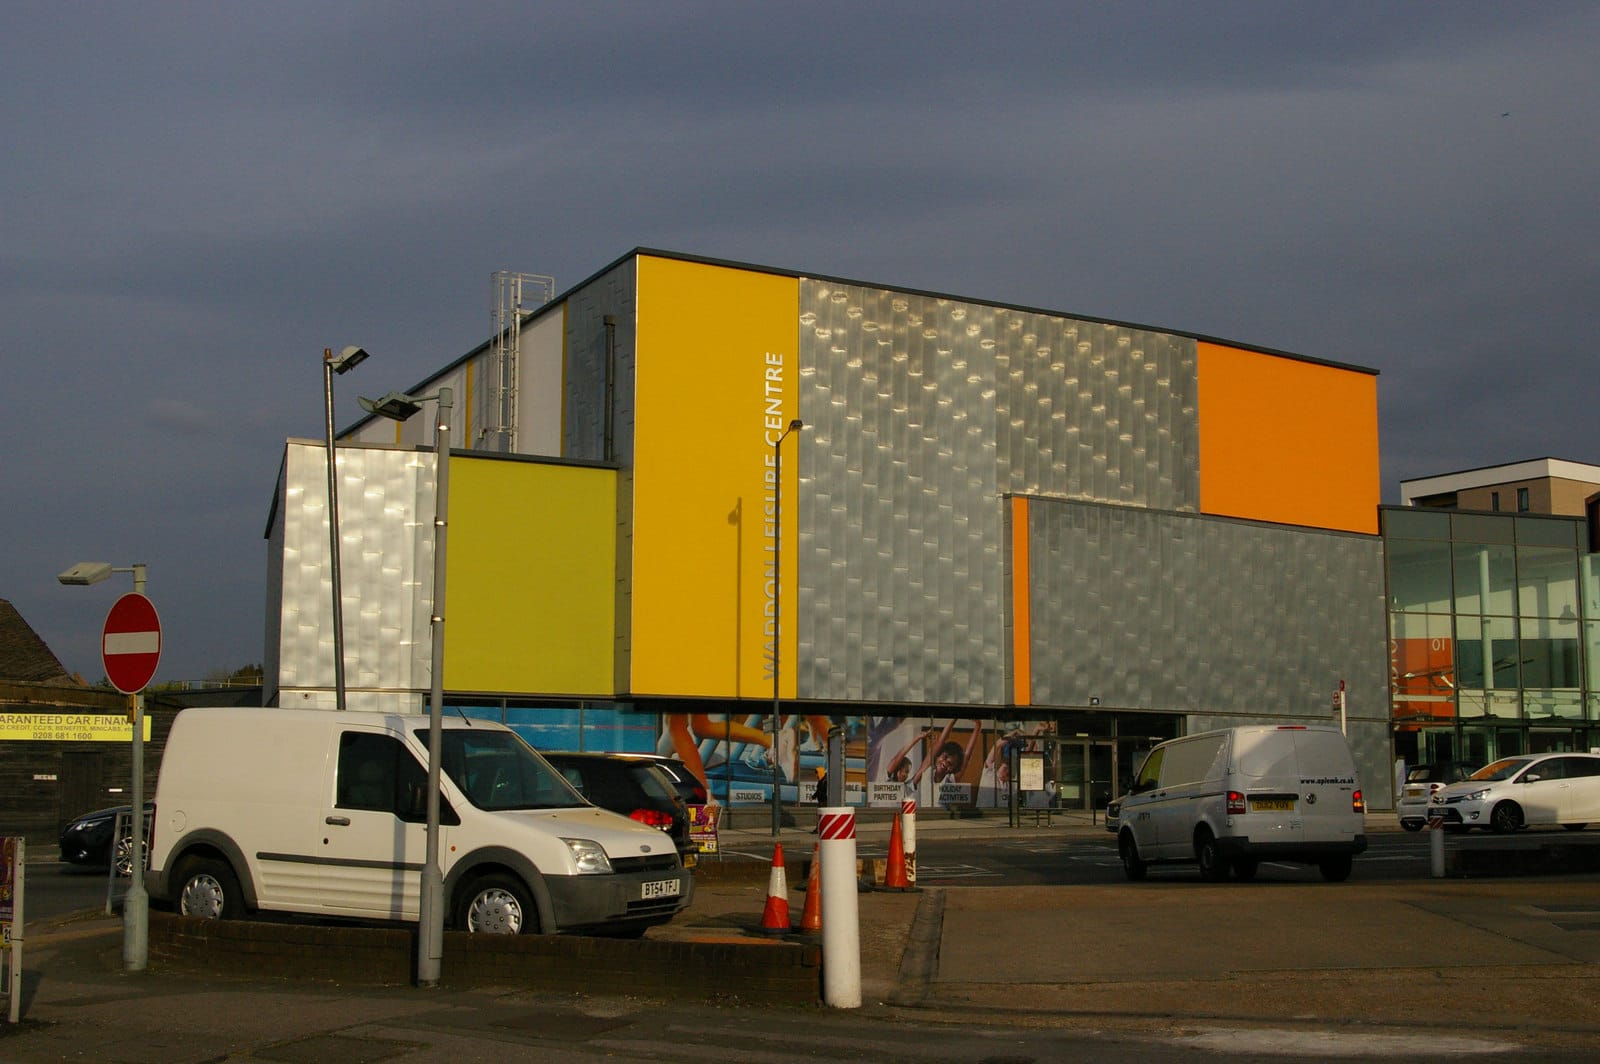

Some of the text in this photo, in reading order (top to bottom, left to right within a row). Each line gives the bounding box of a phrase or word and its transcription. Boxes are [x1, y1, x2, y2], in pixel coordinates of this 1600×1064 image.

[765, 352, 784, 447] CENTRE
[66, 715, 90, 725] CAR
[94, 716, 131, 726] FINAN
[56, 732, 70, 740] 681
[873, 784, 901, 792] BIRTHDAY
[736, 791, 763, 801] STUDIOS
[873, 793, 898, 801] PARTIES
[939, 793, 969, 801] ACTIVITIES
[665, 880, 678, 893] TFJ
